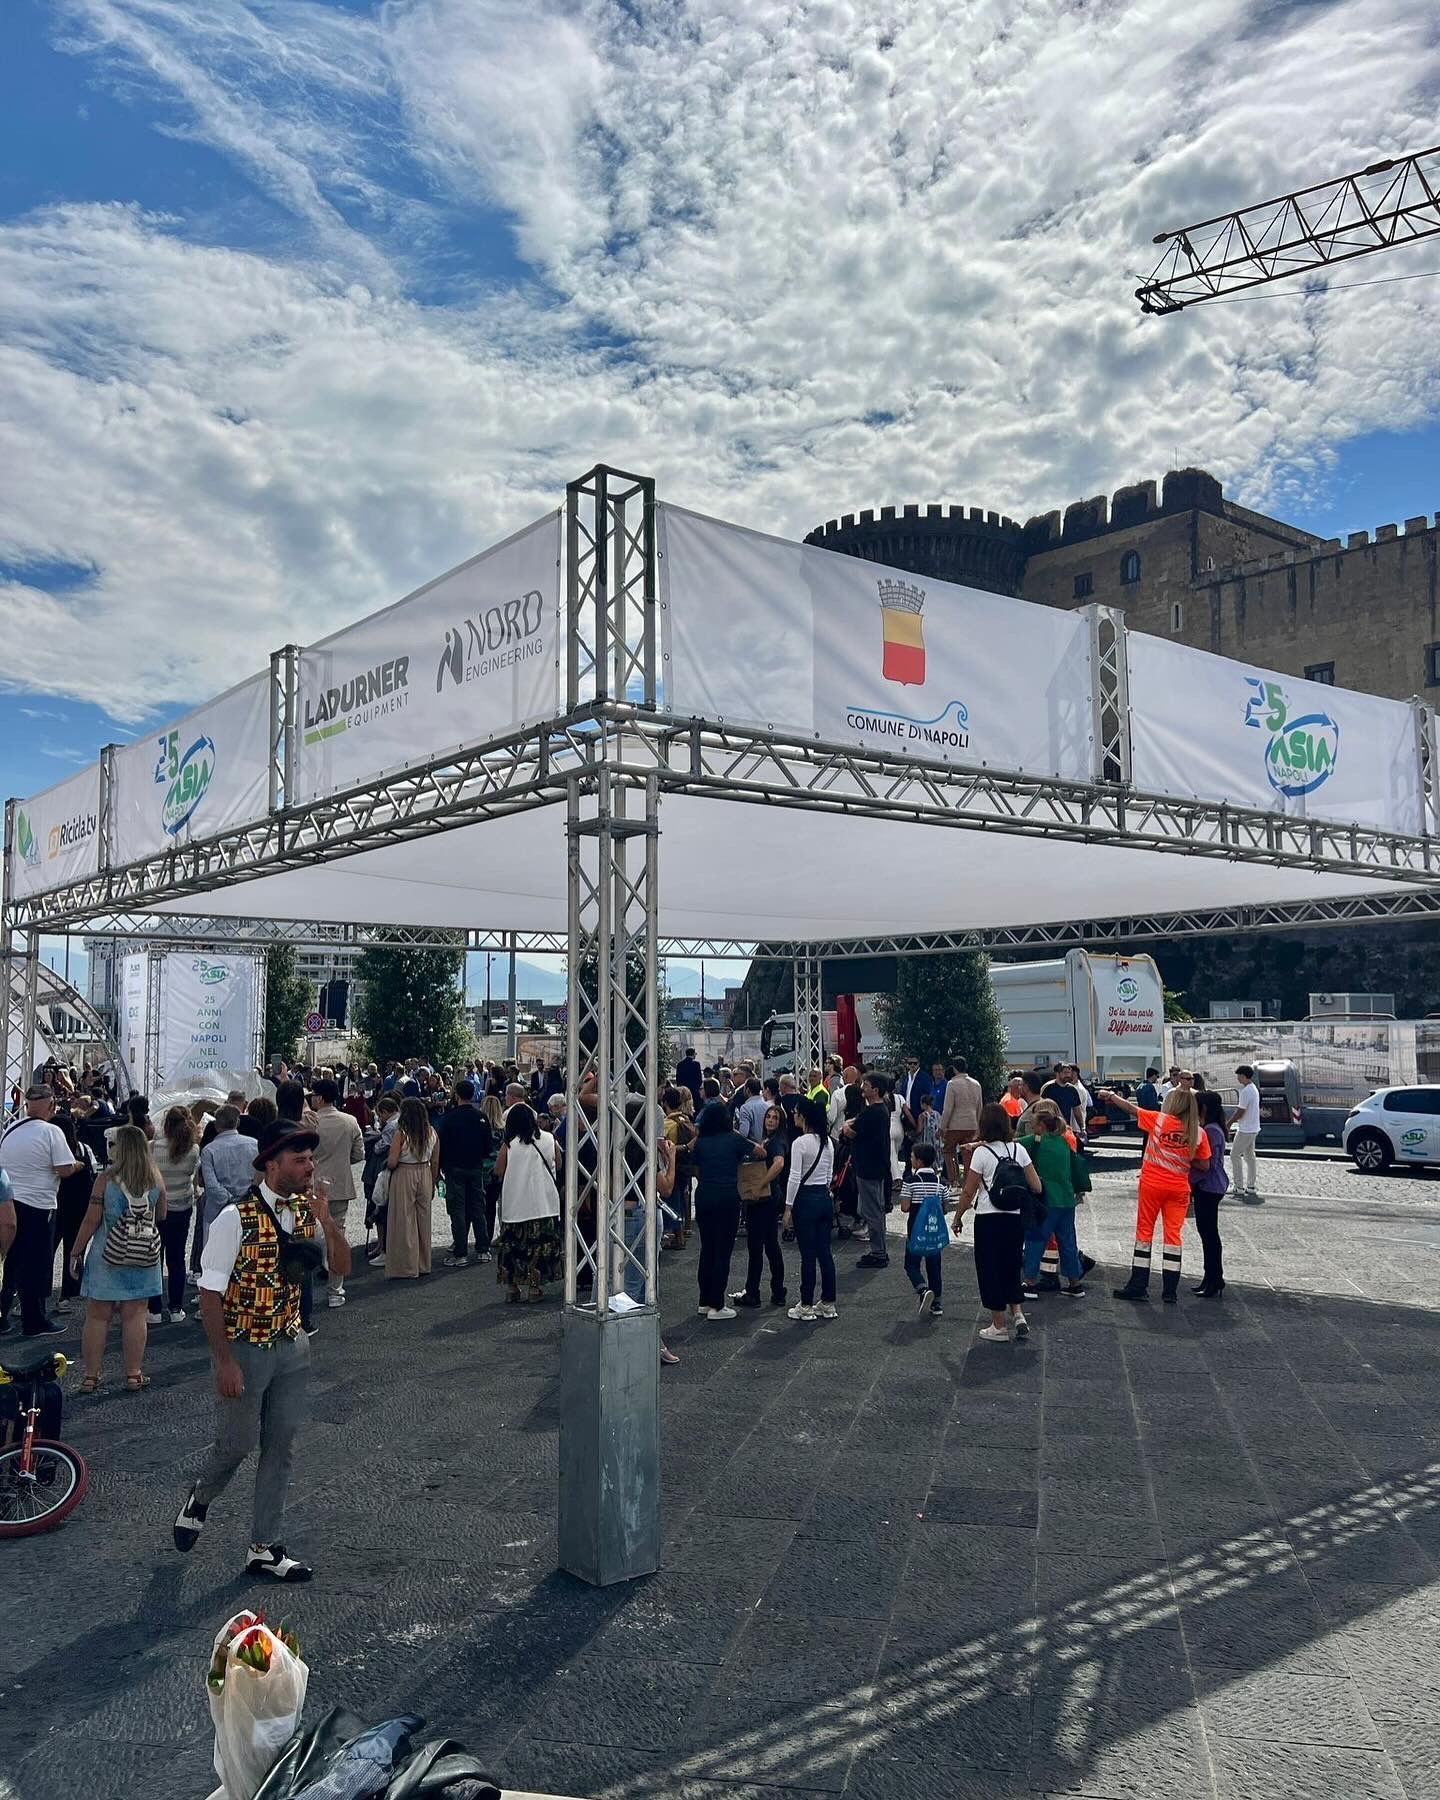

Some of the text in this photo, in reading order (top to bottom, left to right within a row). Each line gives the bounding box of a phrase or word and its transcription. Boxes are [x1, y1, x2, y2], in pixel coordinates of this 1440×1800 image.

[464, 589, 543, 661] NORD
[465, 638, 543, 682] ENGINEERING
[304, 656, 410, 729] LADURNER
[346, 692, 409, 728] EQUIPMENT
[1243, 677, 1287, 731] 25
[847, 714, 969, 748] COMUNE DI NAPOLI
[155, 730, 179, 784] 25
[1270, 730, 1333, 774] ASIA
[1273, 765, 1310, 783] NAPOLI
[167, 759, 209, 808] ASIA
[192, 959, 208, 972] 25
[203, 969, 228, 979] ASIA
[204, 995, 215, 1004] 25
[196, 1008, 222, 1017] ANNI
[1128, 1008, 1137, 1017] tua
[1138, 1008, 1154, 1018] parte
[199, 1021, 220, 1030] CON
[1107, 1019, 1153, 1036] Differenzia
[191, 1035, 227, 1043] NAPOLI
[199, 1048, 218, 1056] NEL
[1402, 1132, 1424, 1141] ASIA
